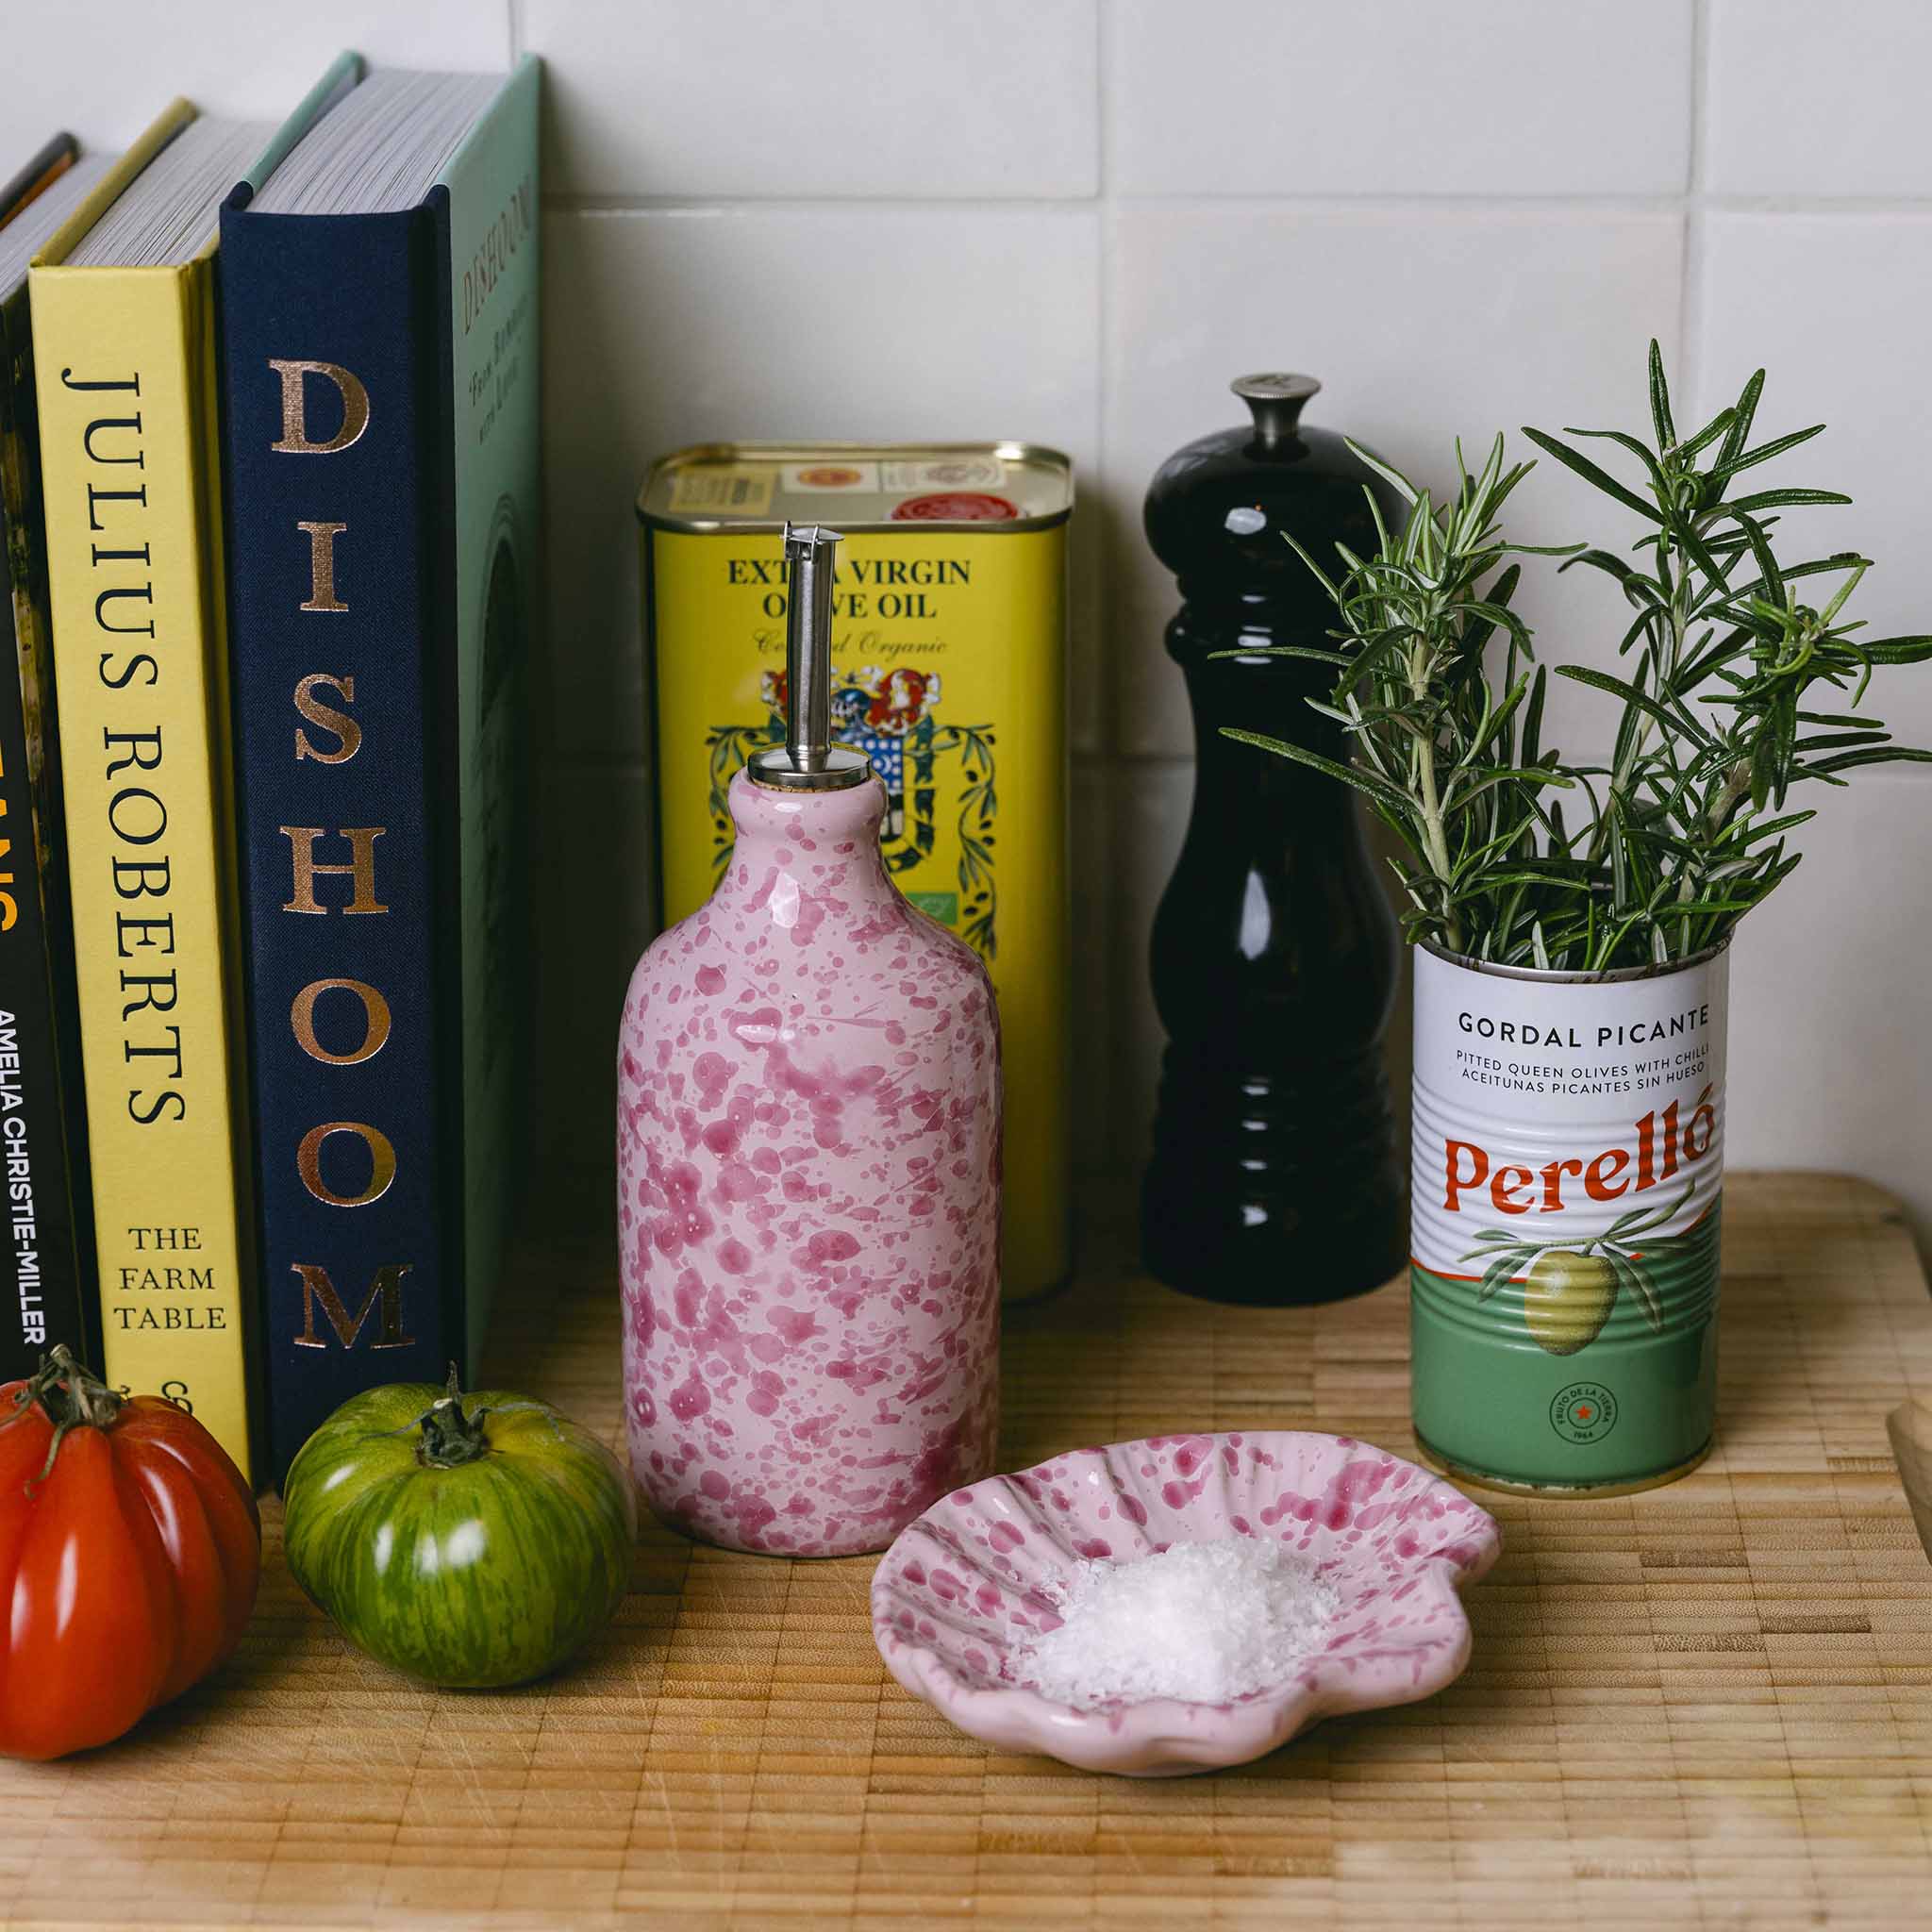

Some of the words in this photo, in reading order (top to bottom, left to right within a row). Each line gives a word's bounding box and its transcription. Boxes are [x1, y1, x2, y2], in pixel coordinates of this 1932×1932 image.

[61, 368, 158, 689] JULIUS
[727, 559, 841, 584] EXT
[851, 558, 970, 585] VIRGIN
[762, 592, 868, 619] OVE
[878, 592, 937, 619] OIL
[859, 630, 947, 662] Organic
[268, 358, 416, 1350] DISHOOM
[104, 725, 186, 1124] ROBERTS
[1458, 1012, 1582, 1048] GORDAL
[1598, 1004, 1709, 1047] PICANTE
[0, 1009, 24, 1112] AMELIA
[1457, 1049, 1502, 1071] PITTED
[1508, 1063, 1563, 1078] QUEEN
[1571, 1065, 1628, 1079] OLIVES
[1635, 1058, 1670, 1074] WITH
[1675, 1041, 1709, 1065] CHILLI
[1462, 1068, 1544, 1093] ACEITUNAS
[1552, 1081, 1630, 1094] PICANTES
[1637, 1074, 1660, 1090] SIN
[1666, 1061, 1705, 1083] HUESO
[1443, 1082, 1715, 1215] Perelló
[3, 1116, 46, 1344] CHRISTIE-MILLER
[128, 1228, 202, 1251] THE
[120, 1268, 215, 1290] FARM
[114, 1307, 226, 1330] TABLE
[1570, 1389, 1583, 1398] DE
[1585, 1388, 1596, 1396] LA
